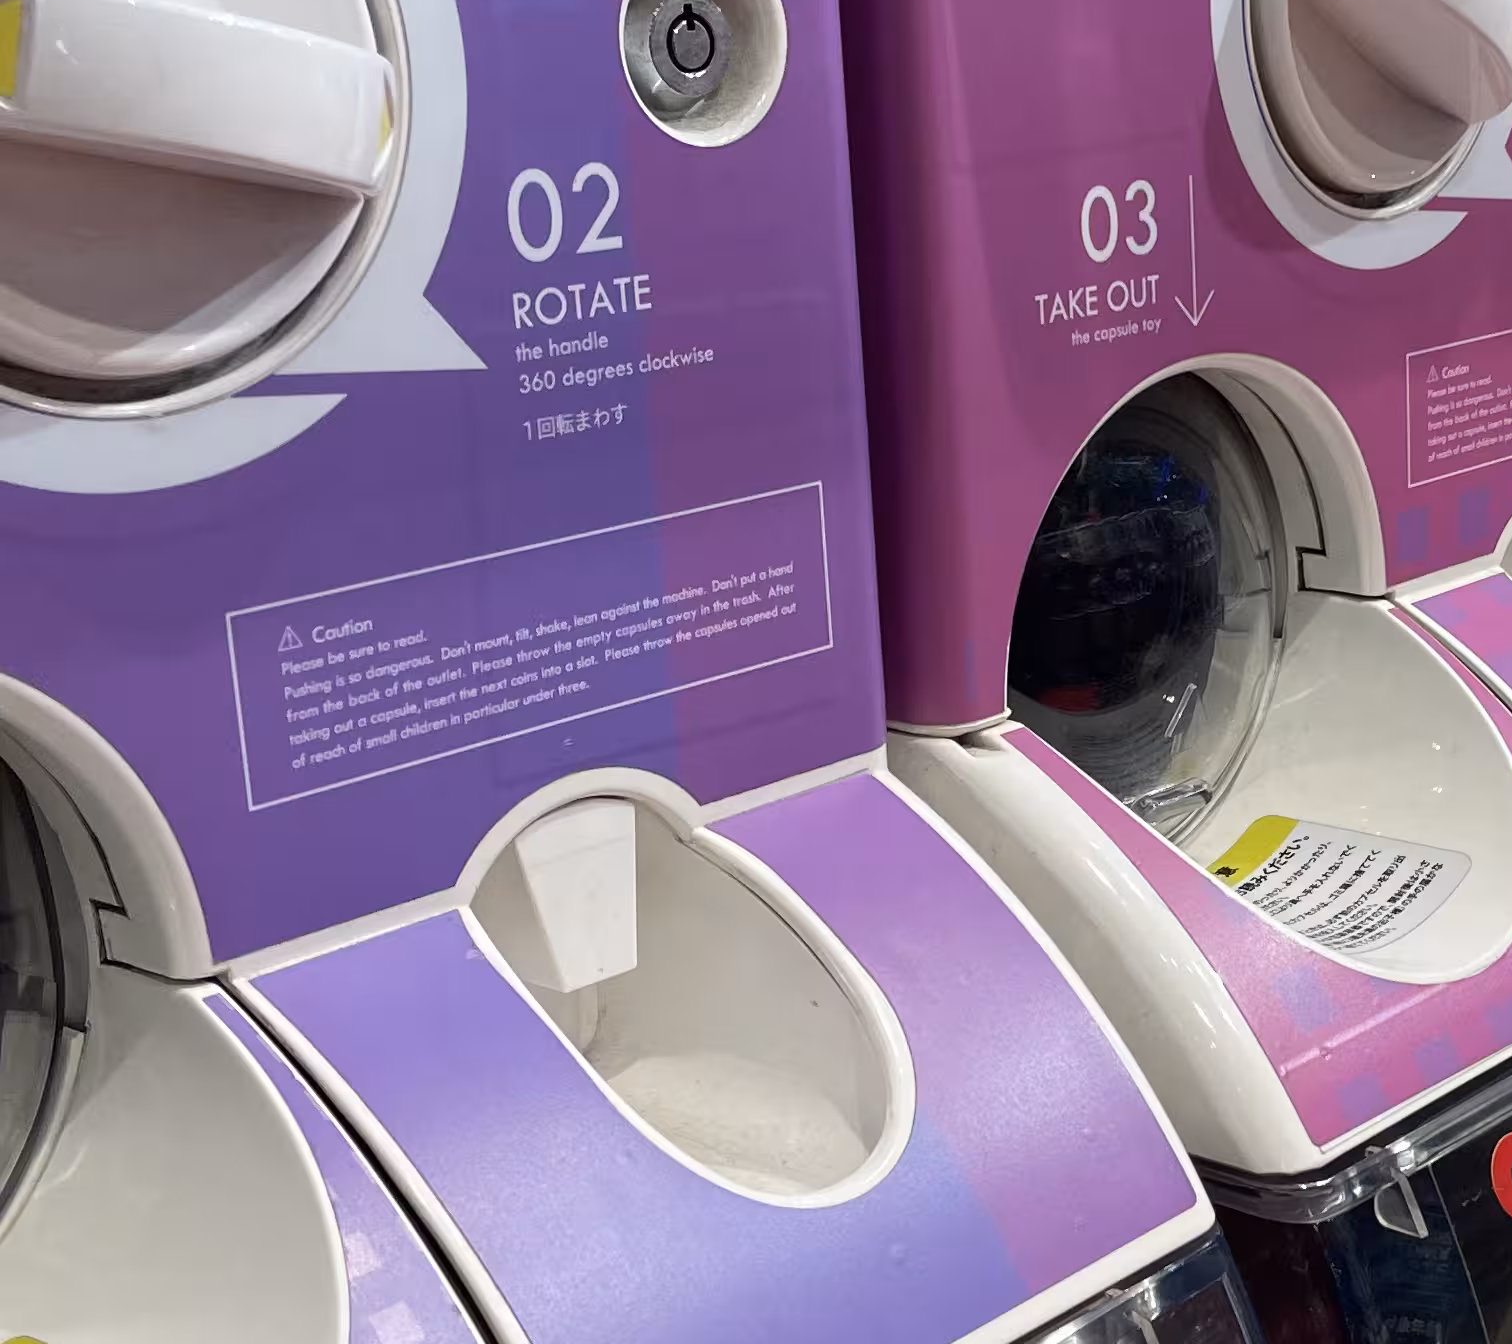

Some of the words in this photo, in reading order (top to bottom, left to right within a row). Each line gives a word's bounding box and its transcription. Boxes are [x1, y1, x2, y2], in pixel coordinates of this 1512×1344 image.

[507, 162, 623, 262] 02
[1081, 180, 1159, 263] 03
[512, 274, 652, 329] ROTATE
[1035, 283, 1100, 326] TAKE
[1106, 274, 1160, 312] OUT
[515, 343, 543, 363] the
[548, 331, 609, 358] handle
[1071, 328, 1091, 347] the
[1094, 319, 1139, 343] capsule
[1142, 316, 1163, 337] toy
[519, 370, 556, 394] 360
[562, 360, 634, 388] degrees
[638, 347, 715, 373] clockwise
[522, 403, 628, 441] 1回転まわす
[281, 654, 323, 675] Please
[348, 644, 373, 659] sure
[393, 629, 427, 648] read.
[284, 677, 331, 701] Pushing
[366, 651, 433, 680] dangerous.
[440, 640, 470, 660] Don't
[475, 632, 512, 653] mount,
[515, 626, 532, 642] tilt,
[535, 616, 571, 638] shake,
[573, 610, 597, 627] lean
[600, 599, 639, 622] against
[643, 594, 658, 609] the
[662, 582, 706, 604] machine.
[712, 574, 736, 592] Don't
[740, 570, 755, 587] put
[768, 560, 792, 577] hand
[312, 614, 373, 643] Caution
[310, 743, 345, 763] reach
[366, 728, 396, 747] small
[400, 715, 447, 738] children
[464, 697, 518, 722] particular
[523, 687, 554, 706] under
[558, 677, 589, 694] three.
